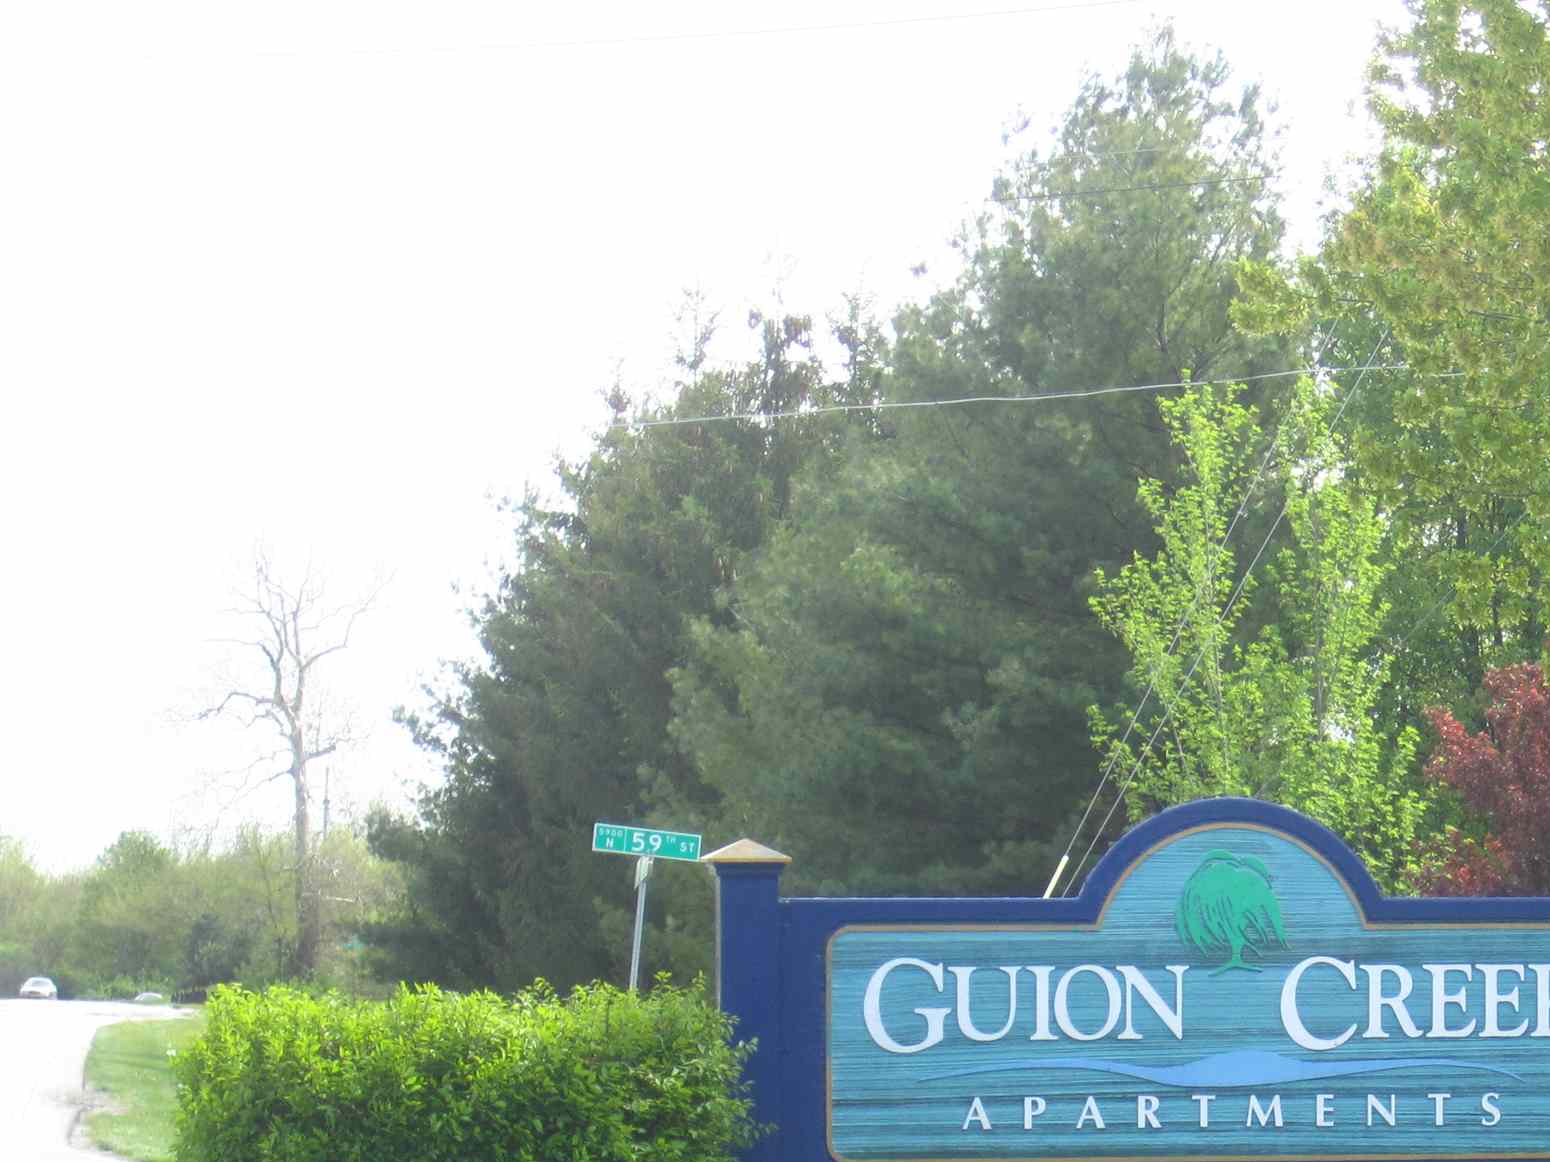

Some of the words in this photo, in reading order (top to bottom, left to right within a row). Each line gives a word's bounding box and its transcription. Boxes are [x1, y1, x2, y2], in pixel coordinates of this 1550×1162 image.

[606, 837, 614, 848] N
[680, 841, 695, 853] ST
[864, 957, 1189, 1053] GUION
[962, 1092, 1502, 1130] APARTMENTS
